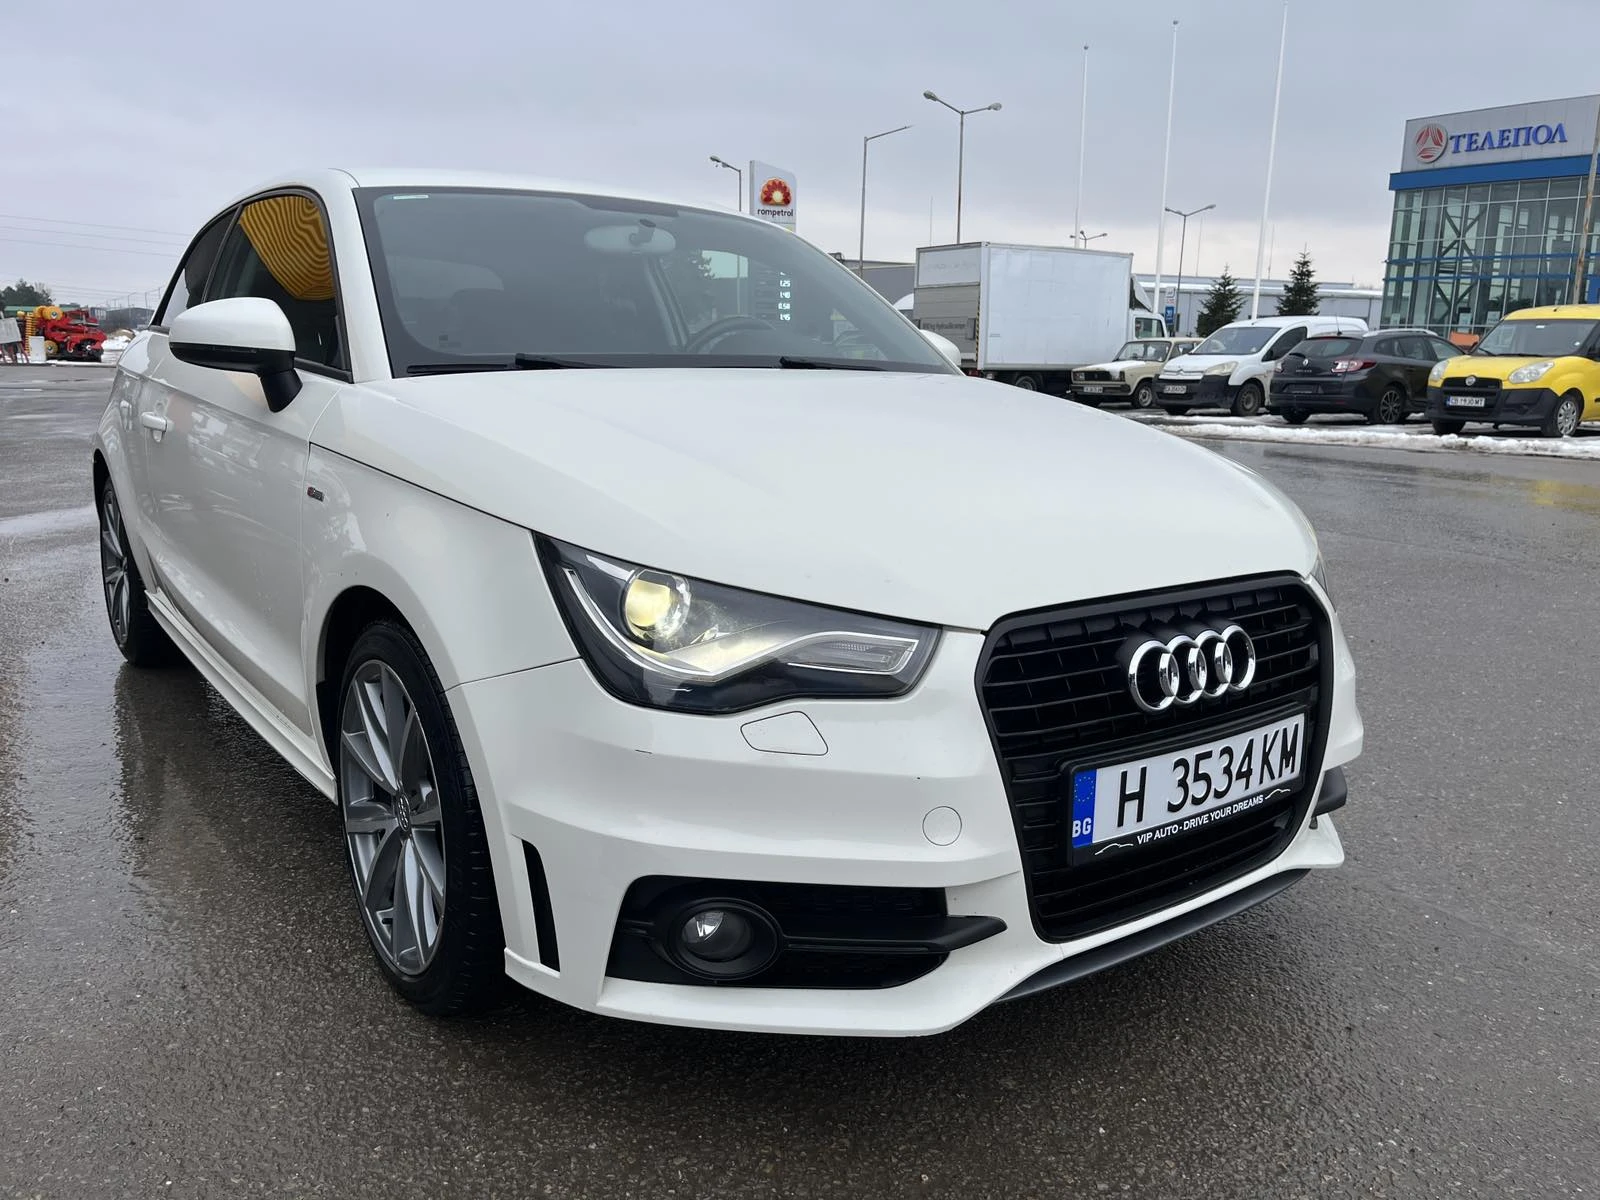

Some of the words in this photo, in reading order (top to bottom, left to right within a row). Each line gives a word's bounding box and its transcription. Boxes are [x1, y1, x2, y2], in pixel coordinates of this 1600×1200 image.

[1450, 122, 1567, 154] ТЕЛЕПОЛ
[757, 208, 794, 218] rompetrol
[1117, 766, 1147, 828] H
[1072, 817, 1092, 838] BG
[1136, 832, 1153, 845] VIP
[1154, 824, 1178, 840] AUTO
[1183, 815, 1209, 831] DRIVE
[1209, 807, 1232, 823] YOUR
[1232, 795, 1264, 813] DREAMS
